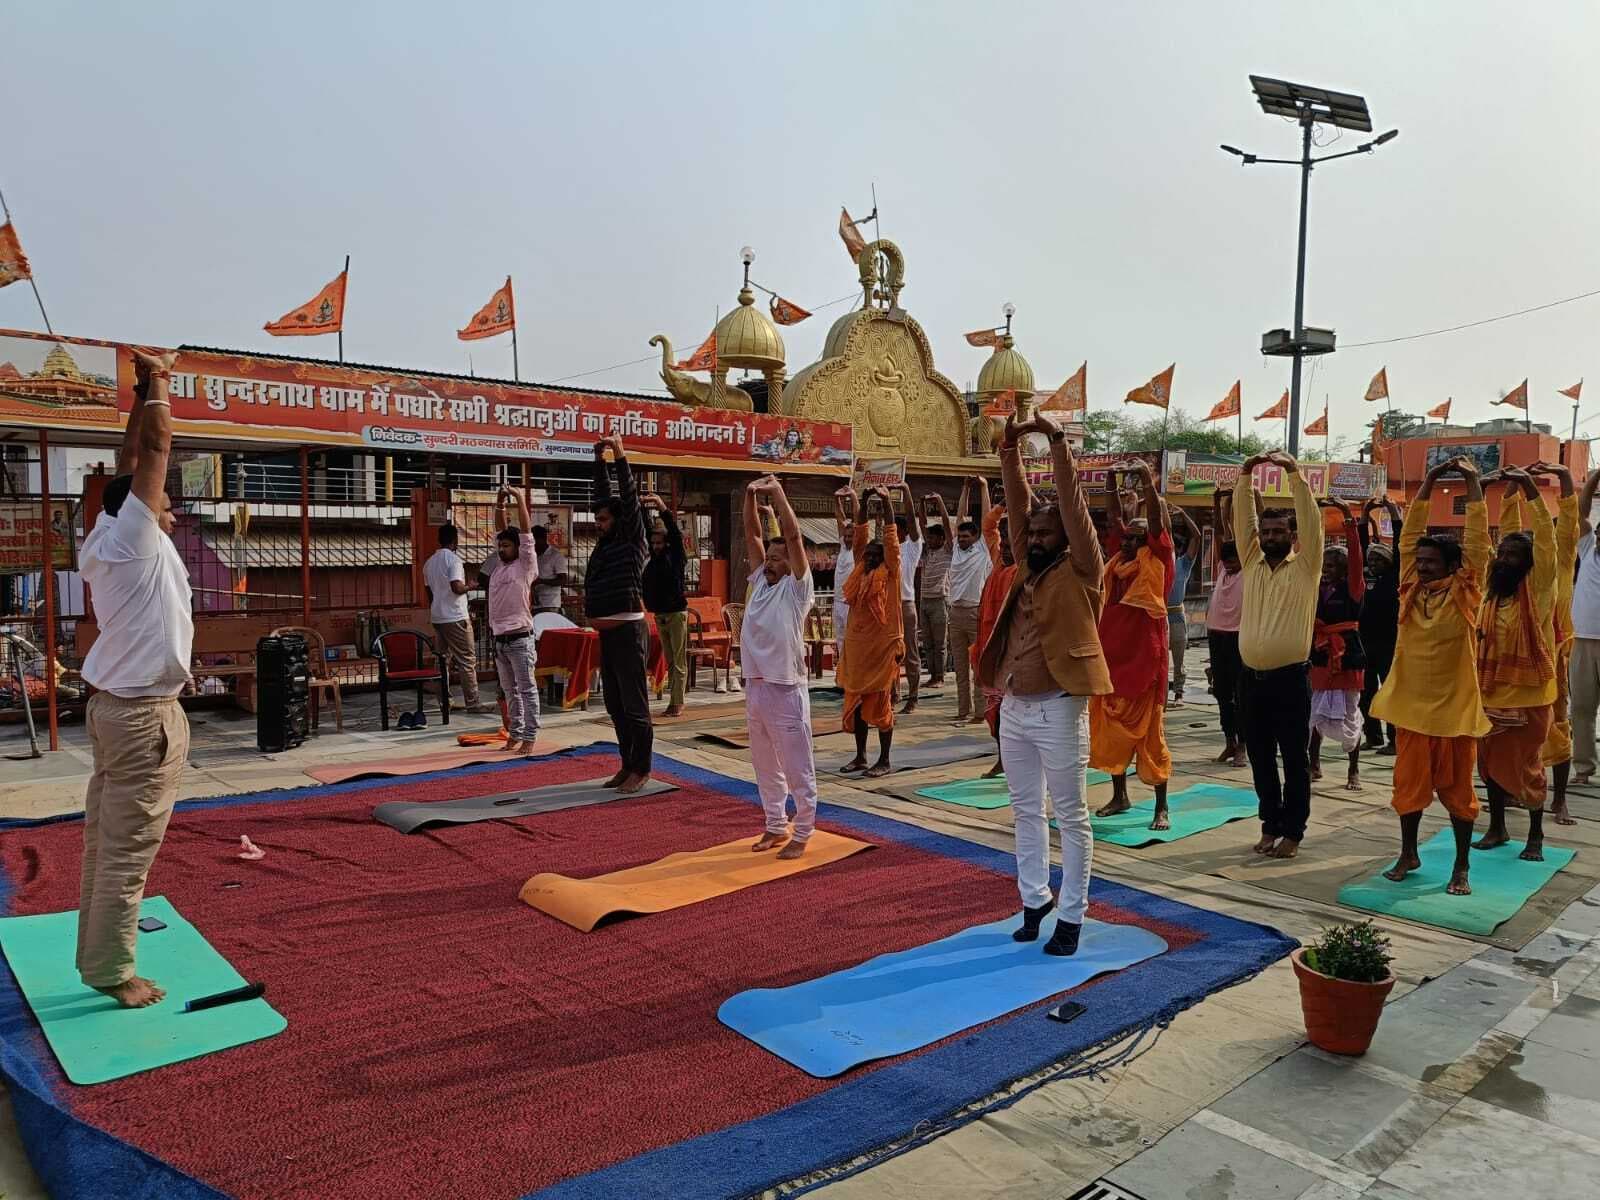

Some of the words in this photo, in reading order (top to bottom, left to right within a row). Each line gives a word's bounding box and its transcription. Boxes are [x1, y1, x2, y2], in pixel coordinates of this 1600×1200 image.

[203, 374, 315, 411] सुन्दरनाथ
[320, 386, 366, 414] धाम
[370, 384, 391, 416] में
[447, 395, 490, 424] सभी
[582, 412, 605, 434] का
[664, 416, 733, 445] अभिनन्दन
[735, 421, 748, 446] है
